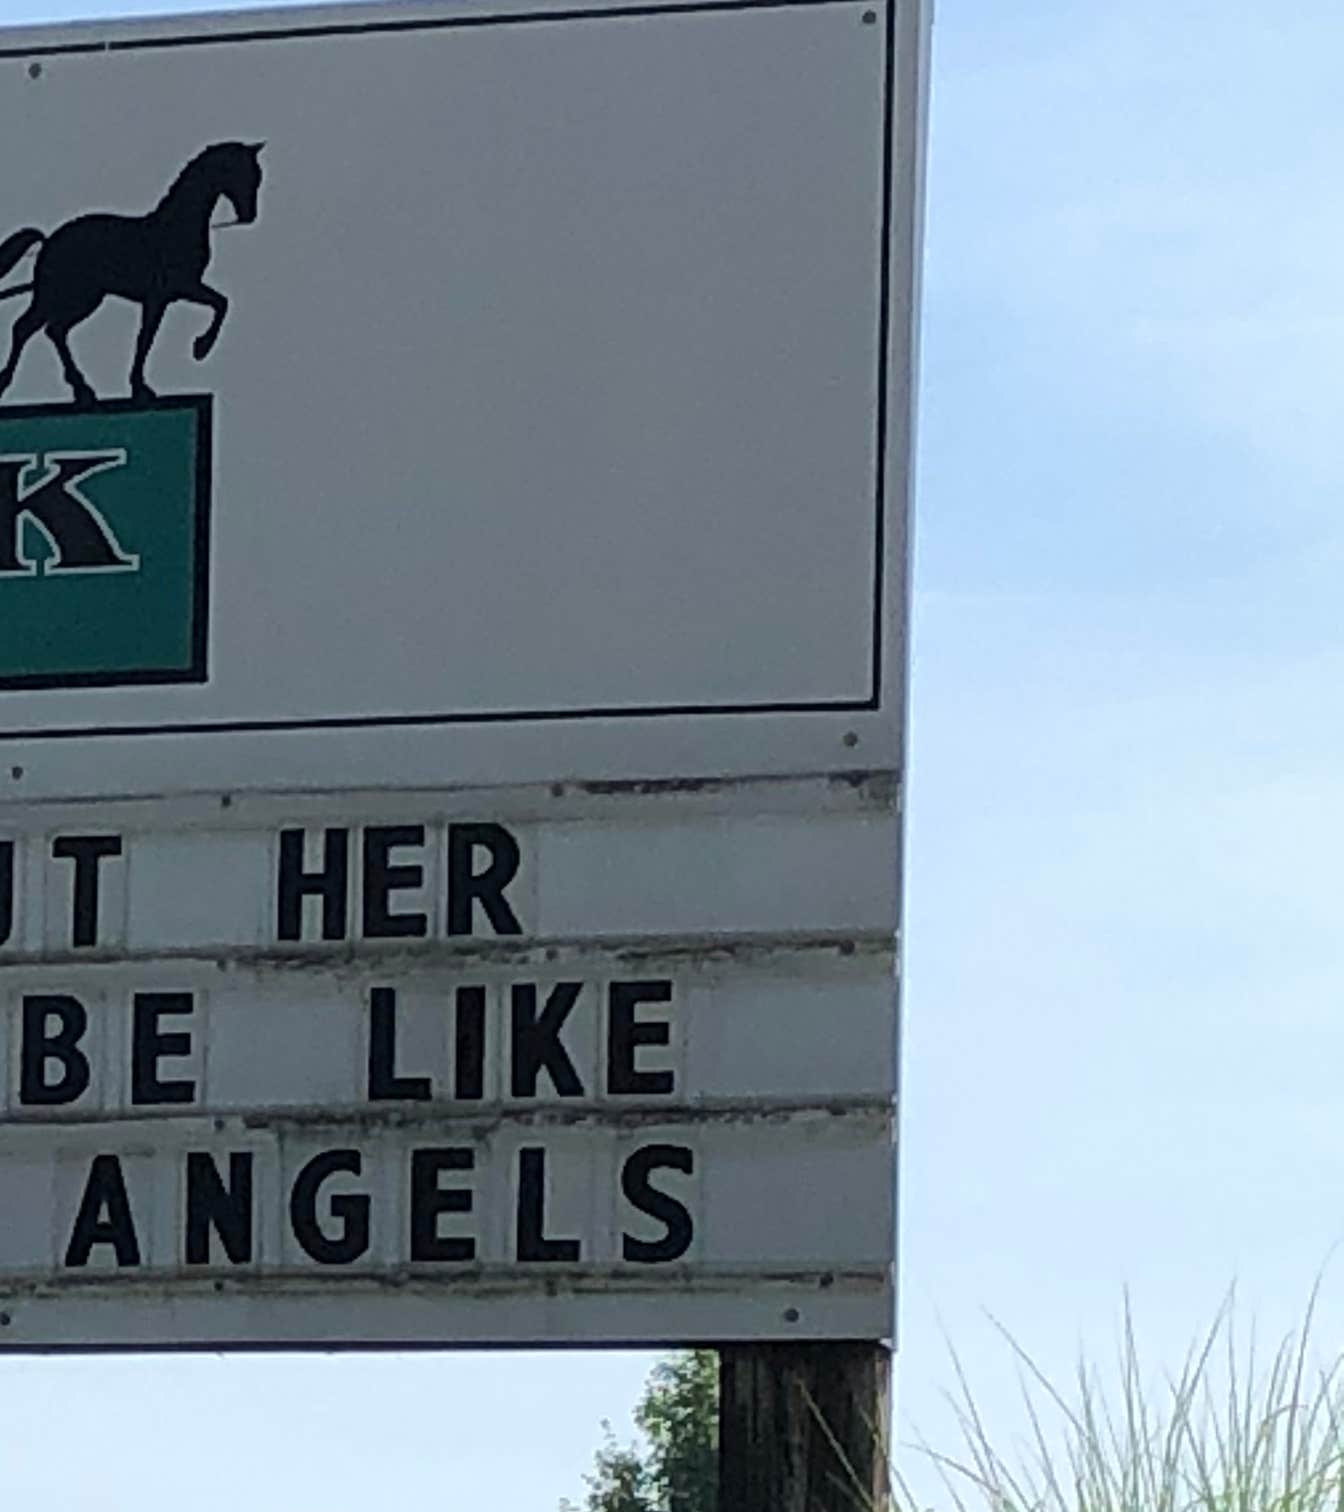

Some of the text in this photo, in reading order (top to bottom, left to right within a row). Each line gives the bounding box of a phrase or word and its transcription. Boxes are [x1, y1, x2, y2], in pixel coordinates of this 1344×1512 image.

[277, 823, 524, 941] HER
[18, 993, 197, 1106] BE
[366, 980, 674, 1102] LIKE
[65, 1146, 694, 1268] ANGELS
